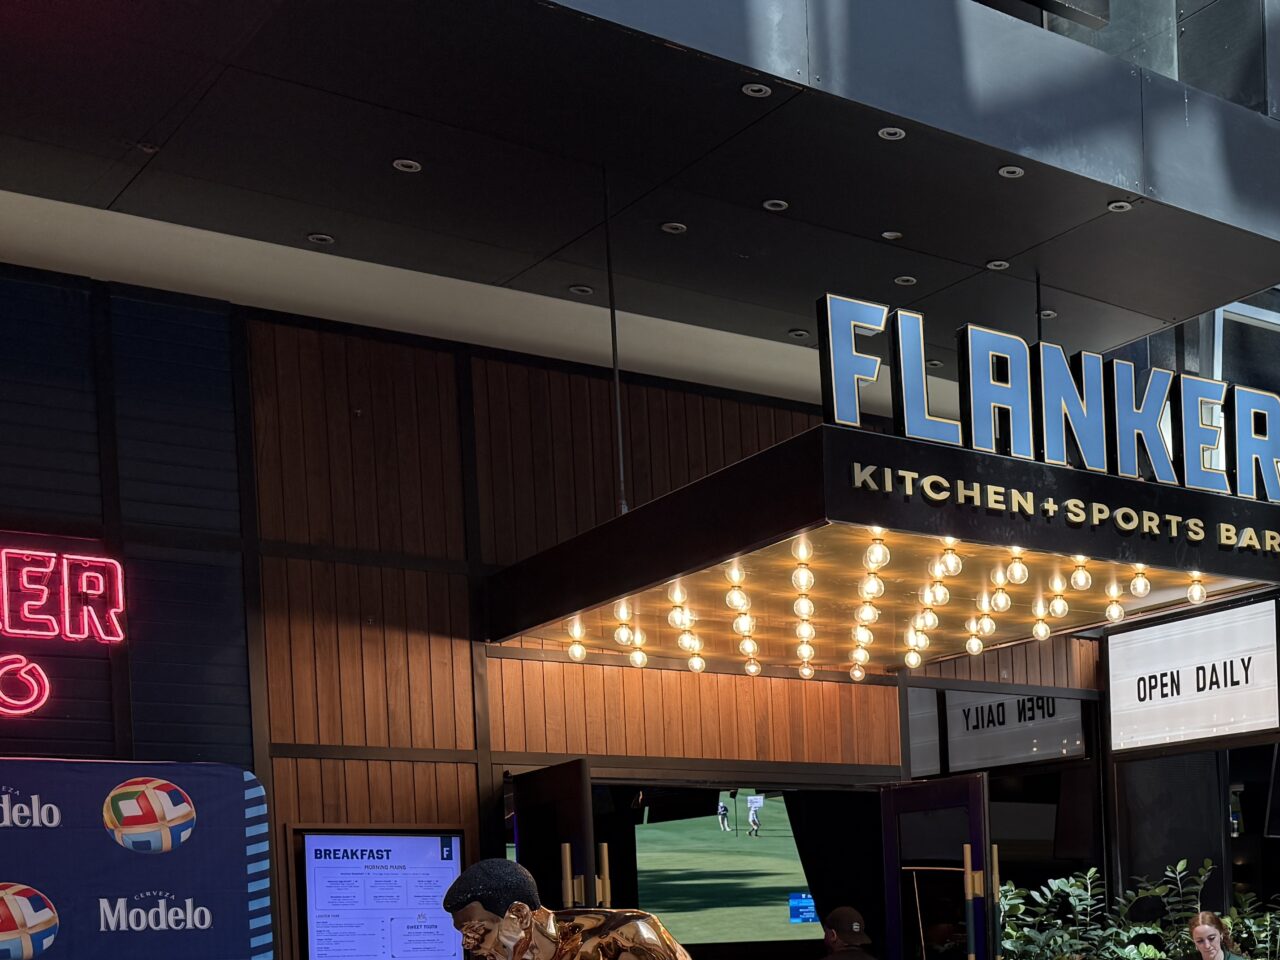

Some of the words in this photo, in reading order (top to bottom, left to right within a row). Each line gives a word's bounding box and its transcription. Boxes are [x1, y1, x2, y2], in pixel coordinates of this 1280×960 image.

[1136, 669, 1182, 703] OPEN
[1195, 656, 1253, 693] DAILY
[314, 848, 392, 860] BREAKFAST
[443, 847, 450, 859] F
[134, 890, 176, 901] CERVEZA
[98, 898, 213, 932] Modelo
